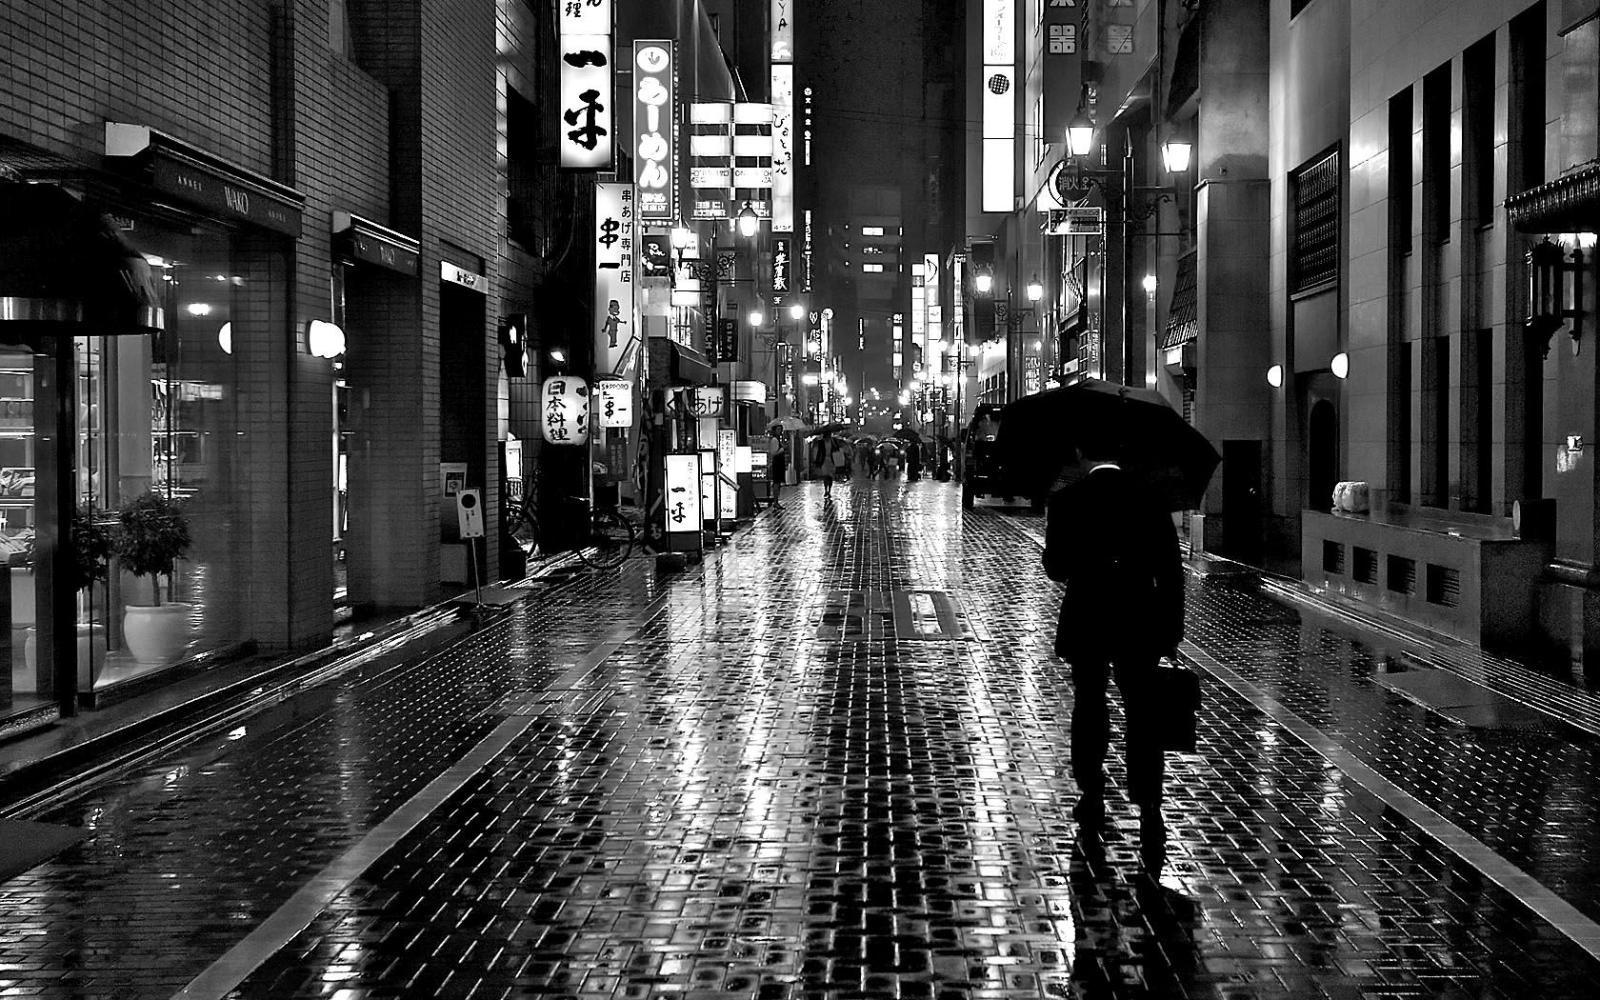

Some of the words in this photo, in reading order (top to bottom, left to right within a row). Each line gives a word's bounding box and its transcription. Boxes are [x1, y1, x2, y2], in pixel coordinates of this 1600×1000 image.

[565, 0, 582, 18] 理
[777, 0, 789, 32] YA
[637, 76, 669, 189] らーめん
[224, 186, 249, 214] WAKO
[598, 217, 621, 269] 串一
[621, 189, 632, 283] 串あげ専門店
[546, 380, 571, 441] 日本料理
